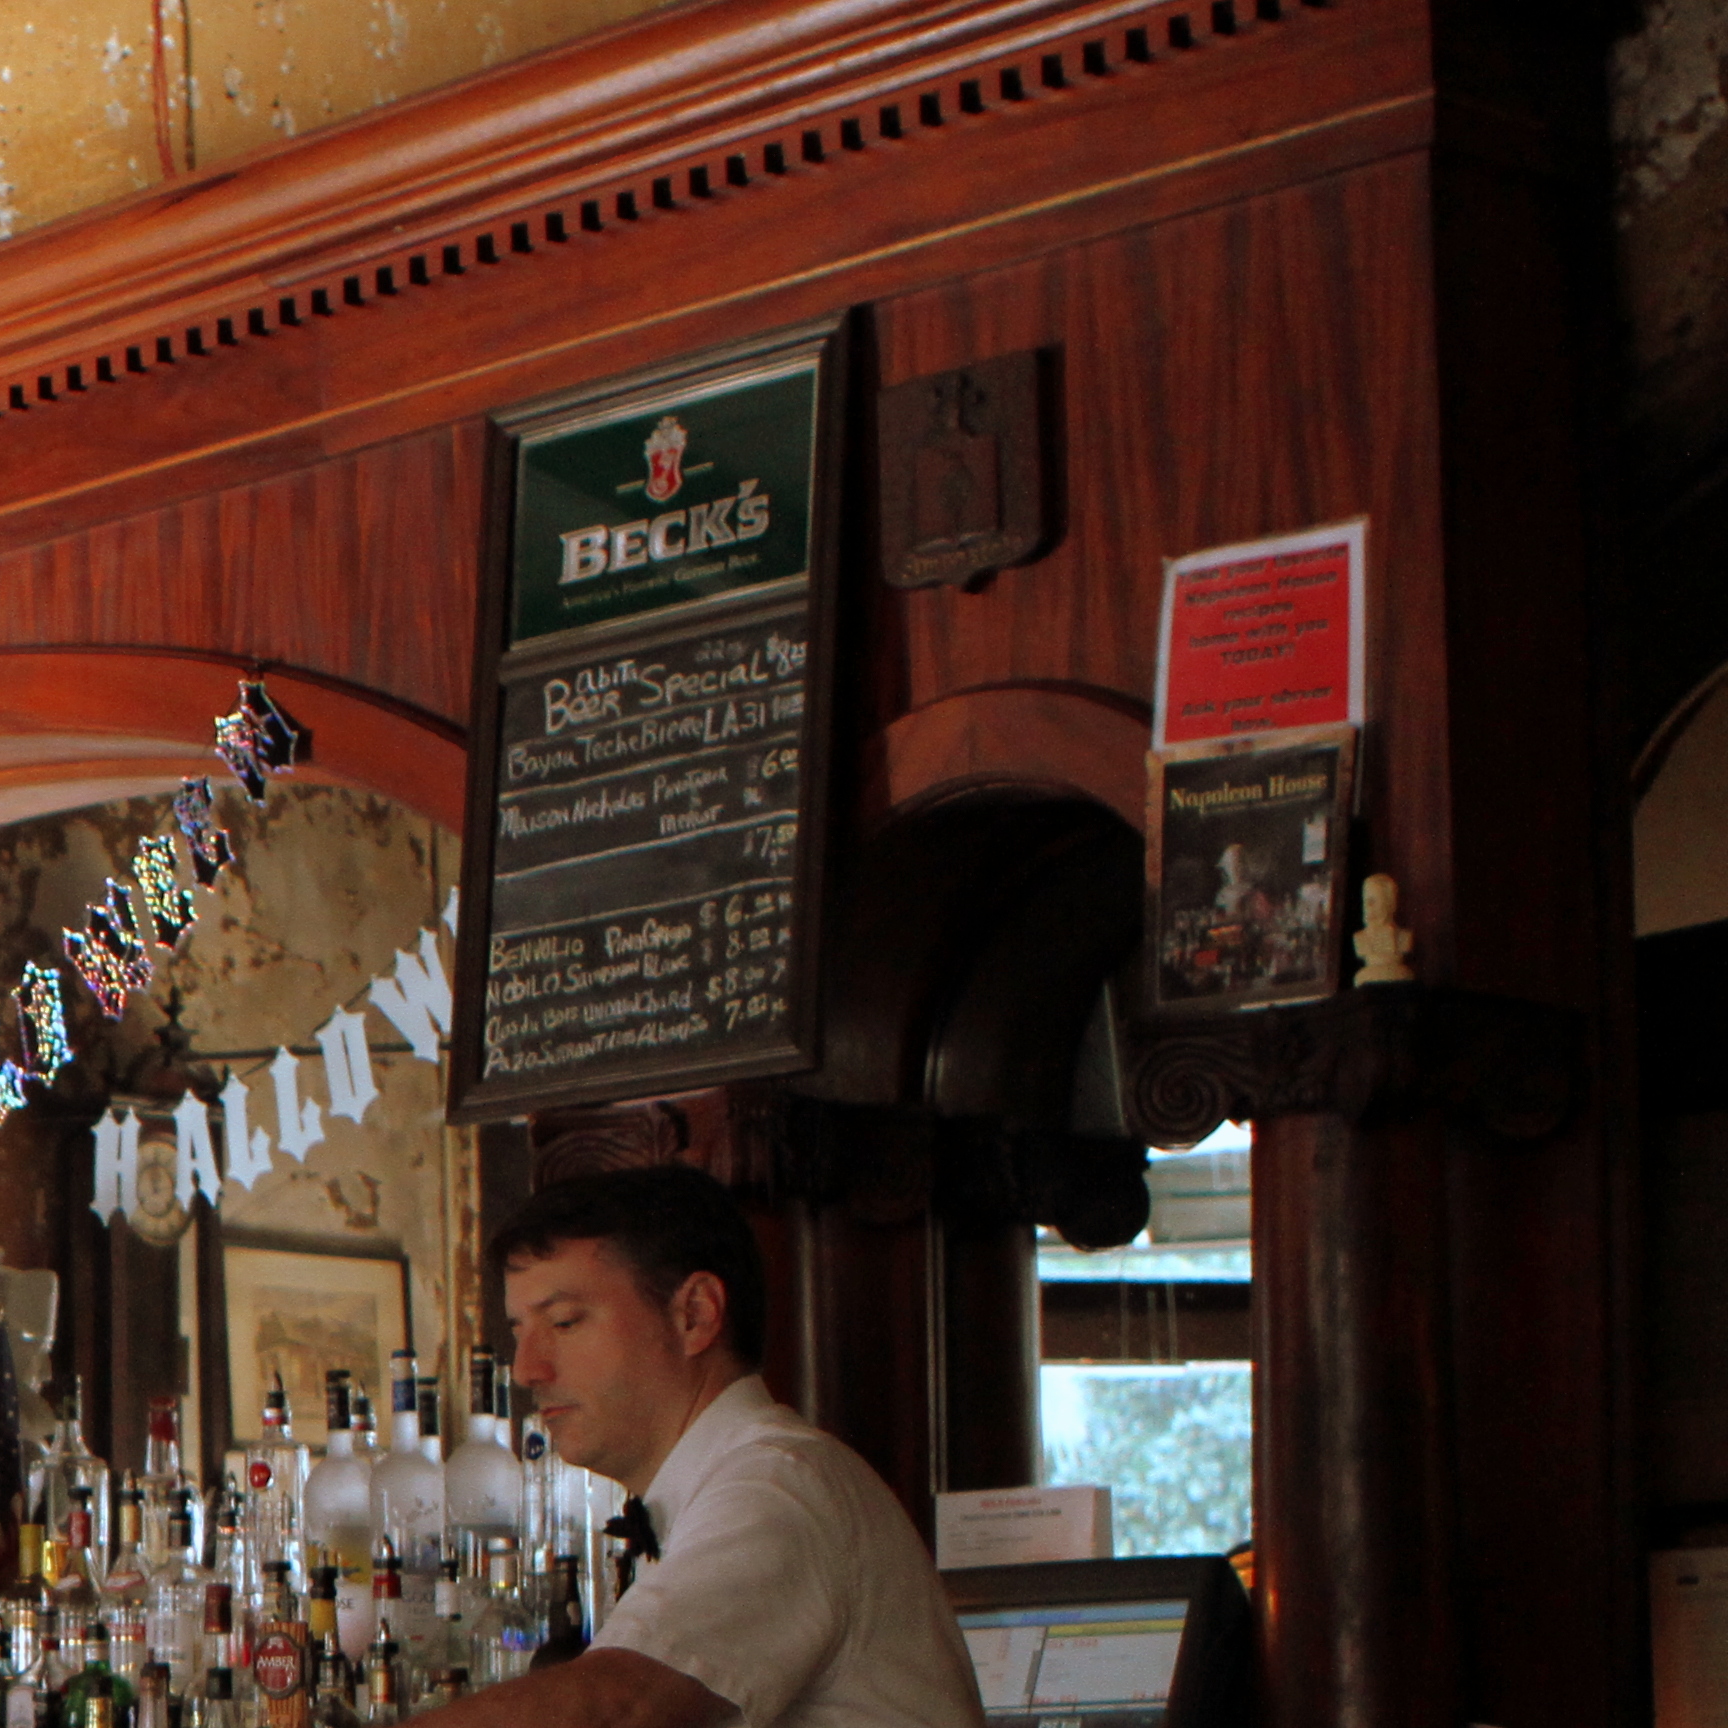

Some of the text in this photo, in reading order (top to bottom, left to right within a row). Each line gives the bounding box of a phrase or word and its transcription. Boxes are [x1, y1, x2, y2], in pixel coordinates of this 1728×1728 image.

[558, 478, 771, 586] BECK'S
[1170, 781, 1264, 816] Napoleon
[1268, 774, 1328, 799] House
[256, 1654, 296, 1673] AMBER
